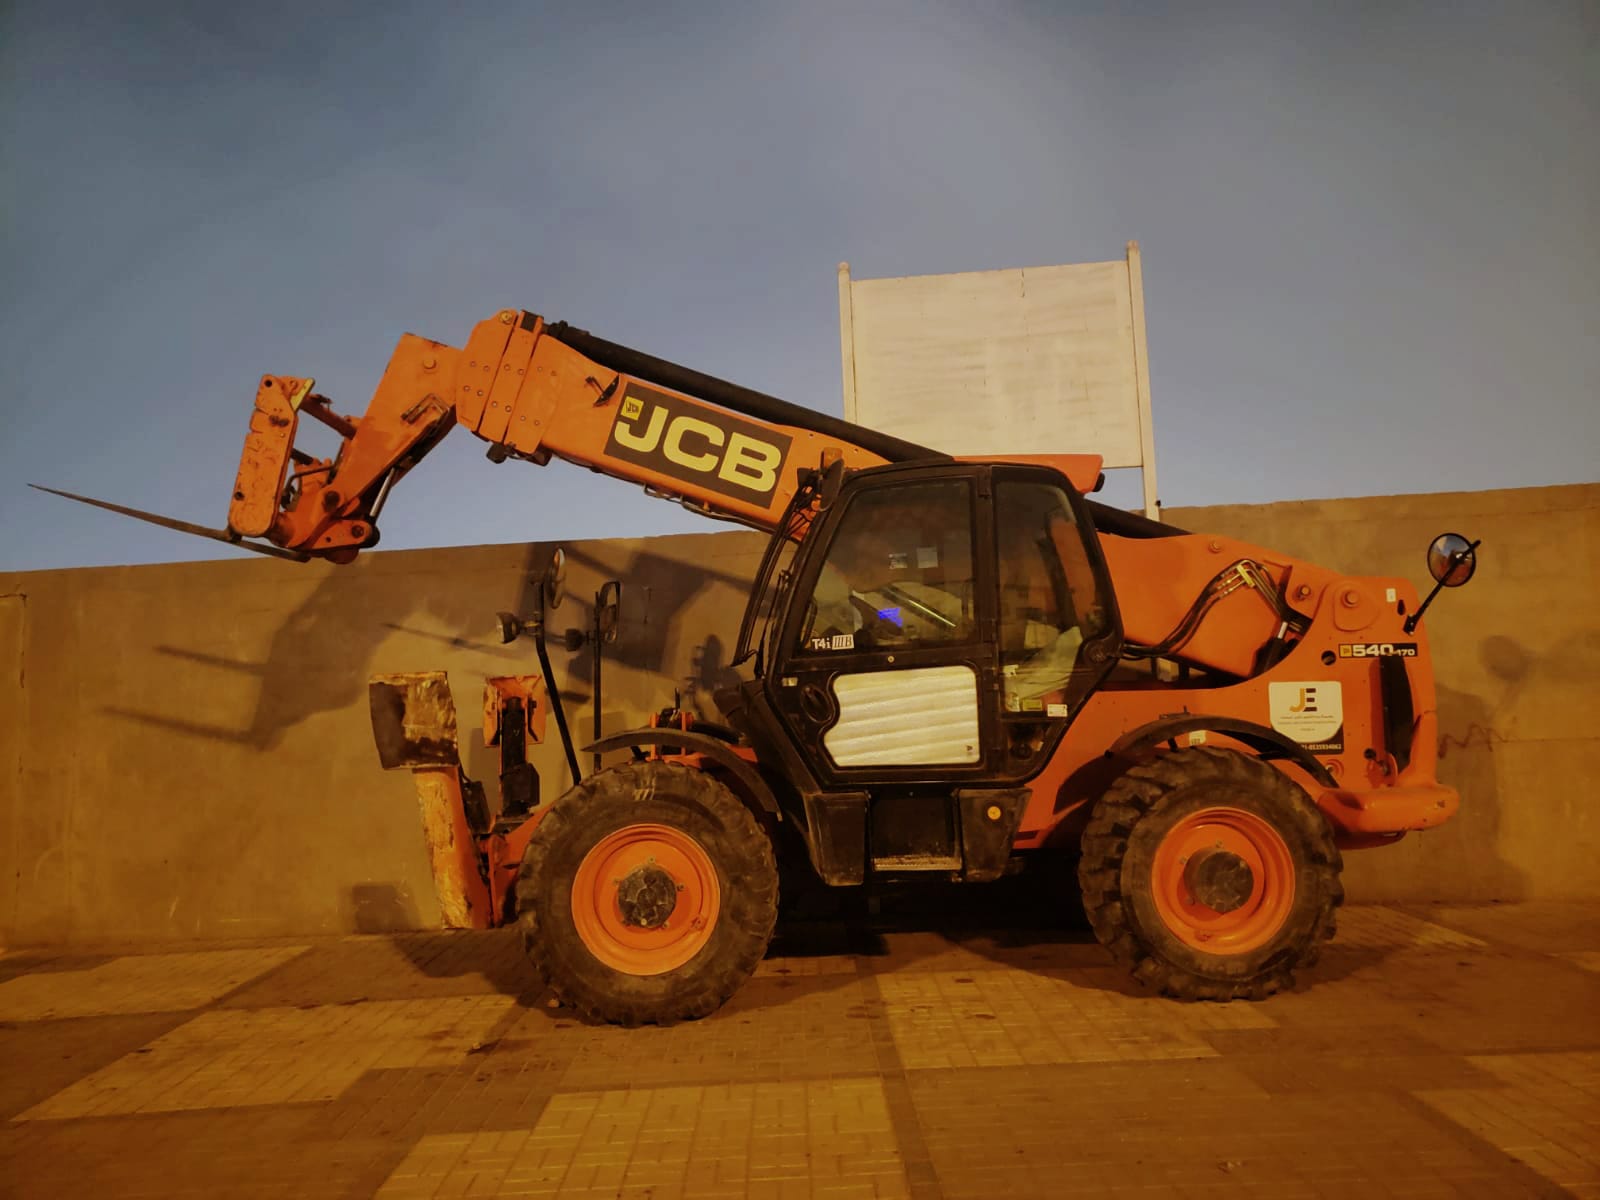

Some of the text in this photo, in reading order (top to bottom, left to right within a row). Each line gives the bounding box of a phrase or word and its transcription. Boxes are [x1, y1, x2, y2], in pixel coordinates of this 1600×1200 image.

[614, 405, 782, 492] JCB
[811, 637, 831, 650] T4i
[1289, 687, 1318, 712] JE
